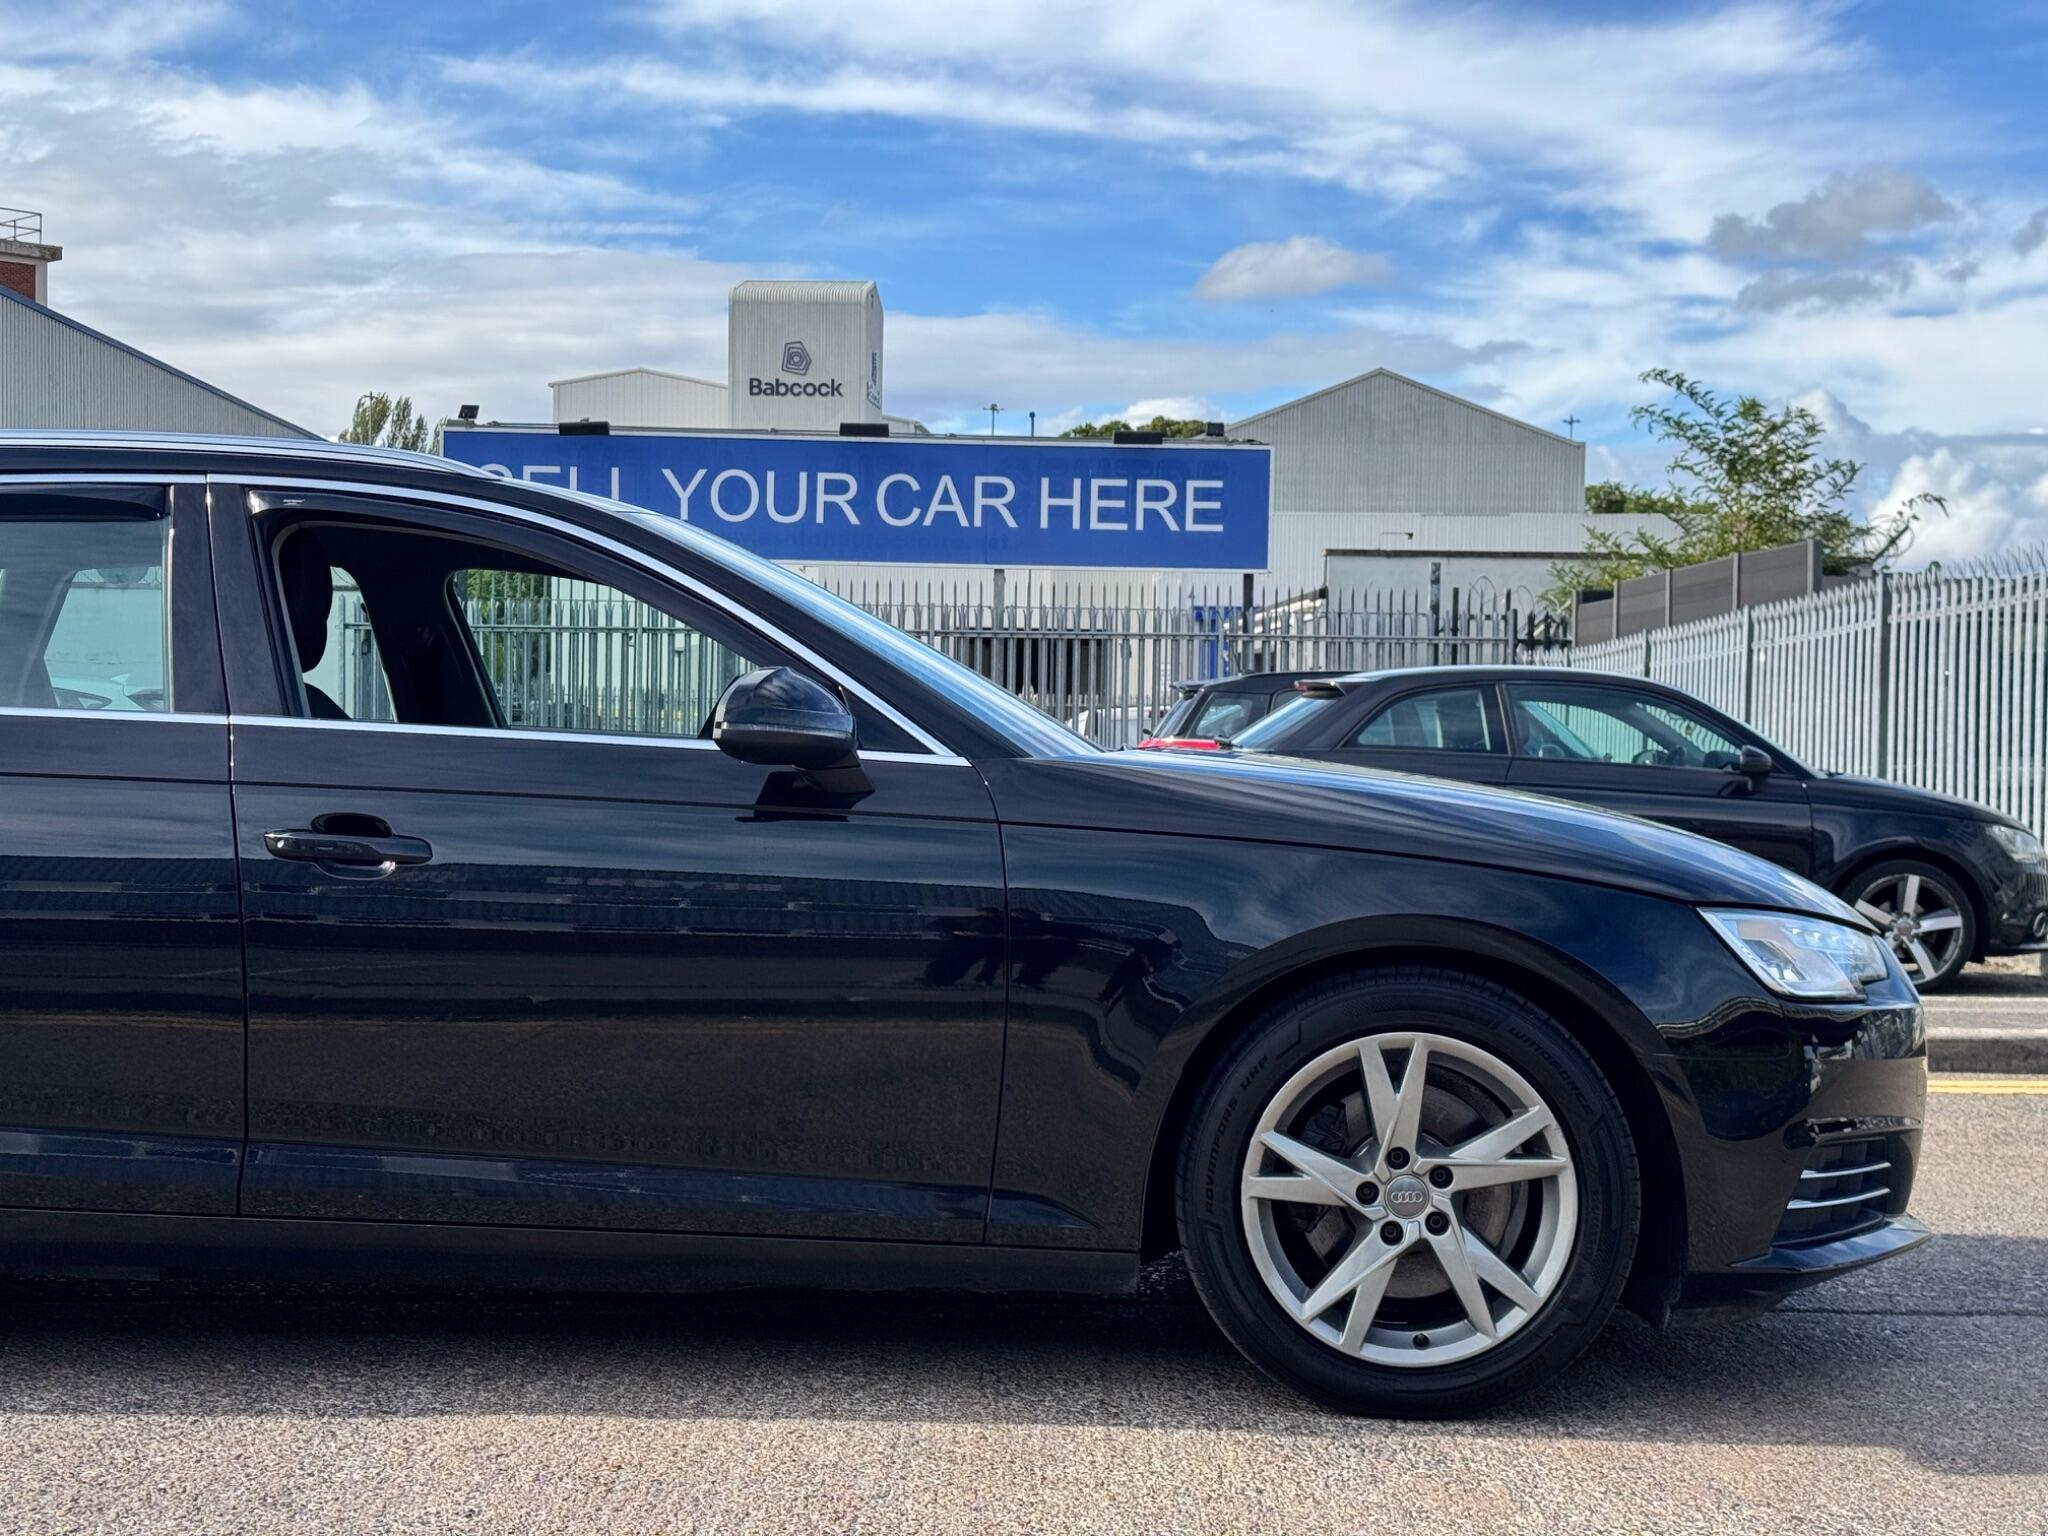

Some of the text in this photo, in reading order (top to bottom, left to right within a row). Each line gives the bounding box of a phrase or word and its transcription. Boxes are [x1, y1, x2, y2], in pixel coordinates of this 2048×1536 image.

[749, 377, 844, 398] Babcock
[661, 468, 861, 526] YOUR
[876, 473, 1019, 529] CAR
[1039, 477, 1224, 532] HERE
